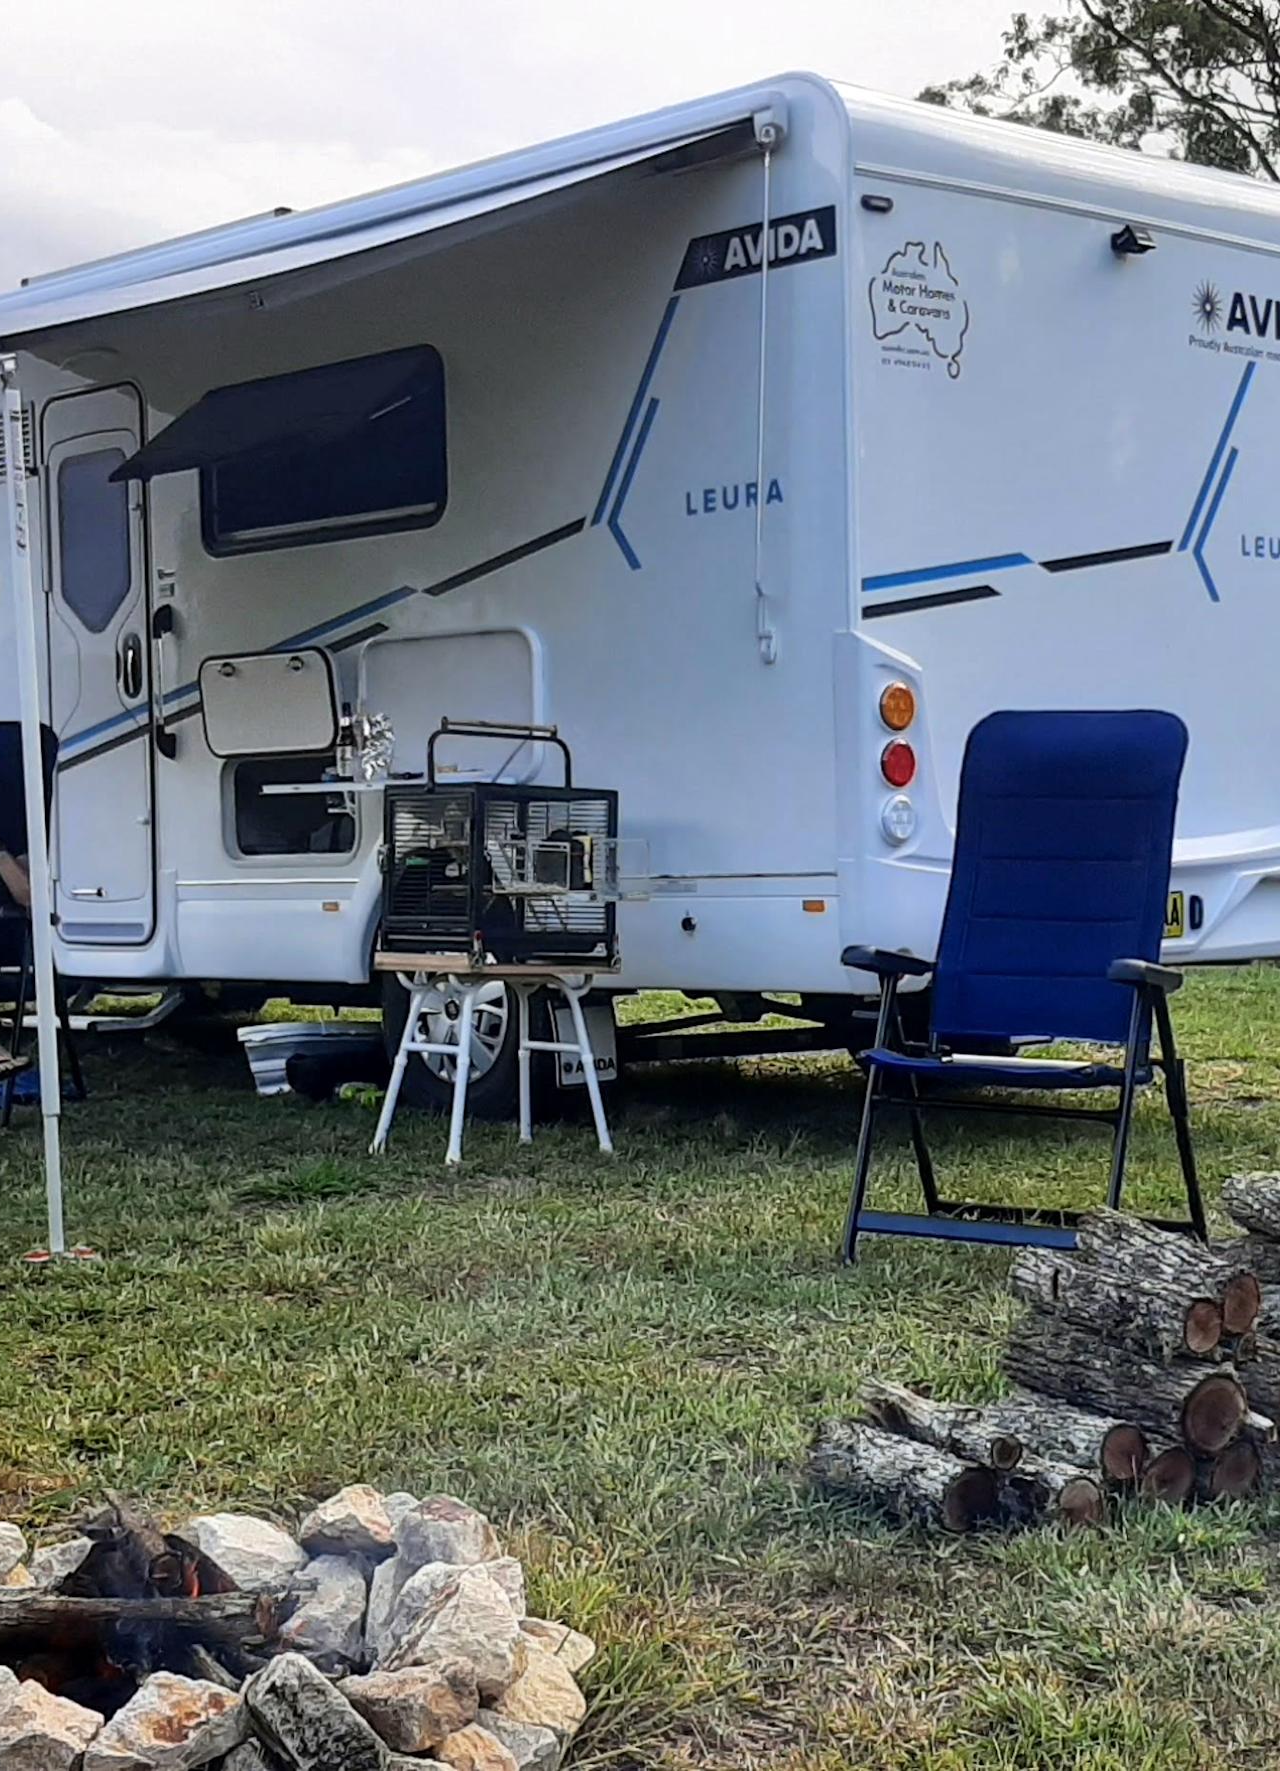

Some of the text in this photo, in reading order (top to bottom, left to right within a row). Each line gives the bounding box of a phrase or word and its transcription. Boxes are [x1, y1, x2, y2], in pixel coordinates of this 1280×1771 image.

[724, 218, 824, 272] AVIDA
[883, 280, 956, 301] Motor Homes
[888, 298, 951, 320] & Caravans
[1189, 334, 1220, 351] Proudly
[1223, 342, 1264, 358] Australian
[685, 479, 784, 516] LEURA
[575, 1056, 616, 1074] AIDA
